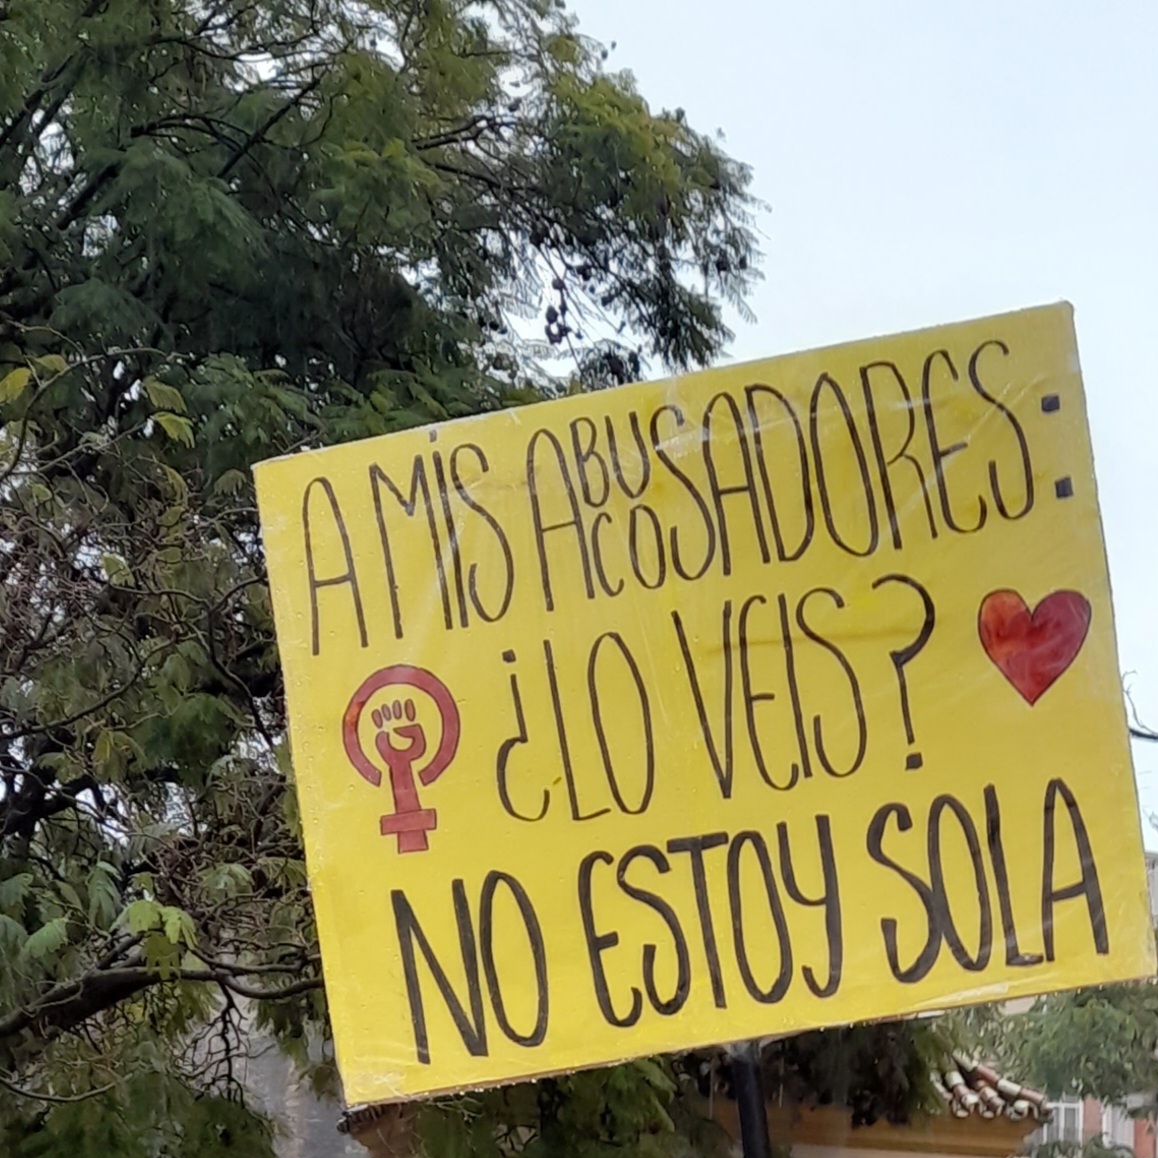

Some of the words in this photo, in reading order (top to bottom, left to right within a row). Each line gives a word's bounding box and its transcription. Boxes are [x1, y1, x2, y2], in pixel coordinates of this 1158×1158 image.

[302, 477, 368, 656] A
[369, 430, 514, 639] MIS
[497, 632, 652, 822] ¿LO
[671, 573, 935, 798] VEIS?
[390, 870, 548, 1065] NO
[578, 814, 843, 1027] ESTOY
[866, 778, 1109, 983] SOLA
